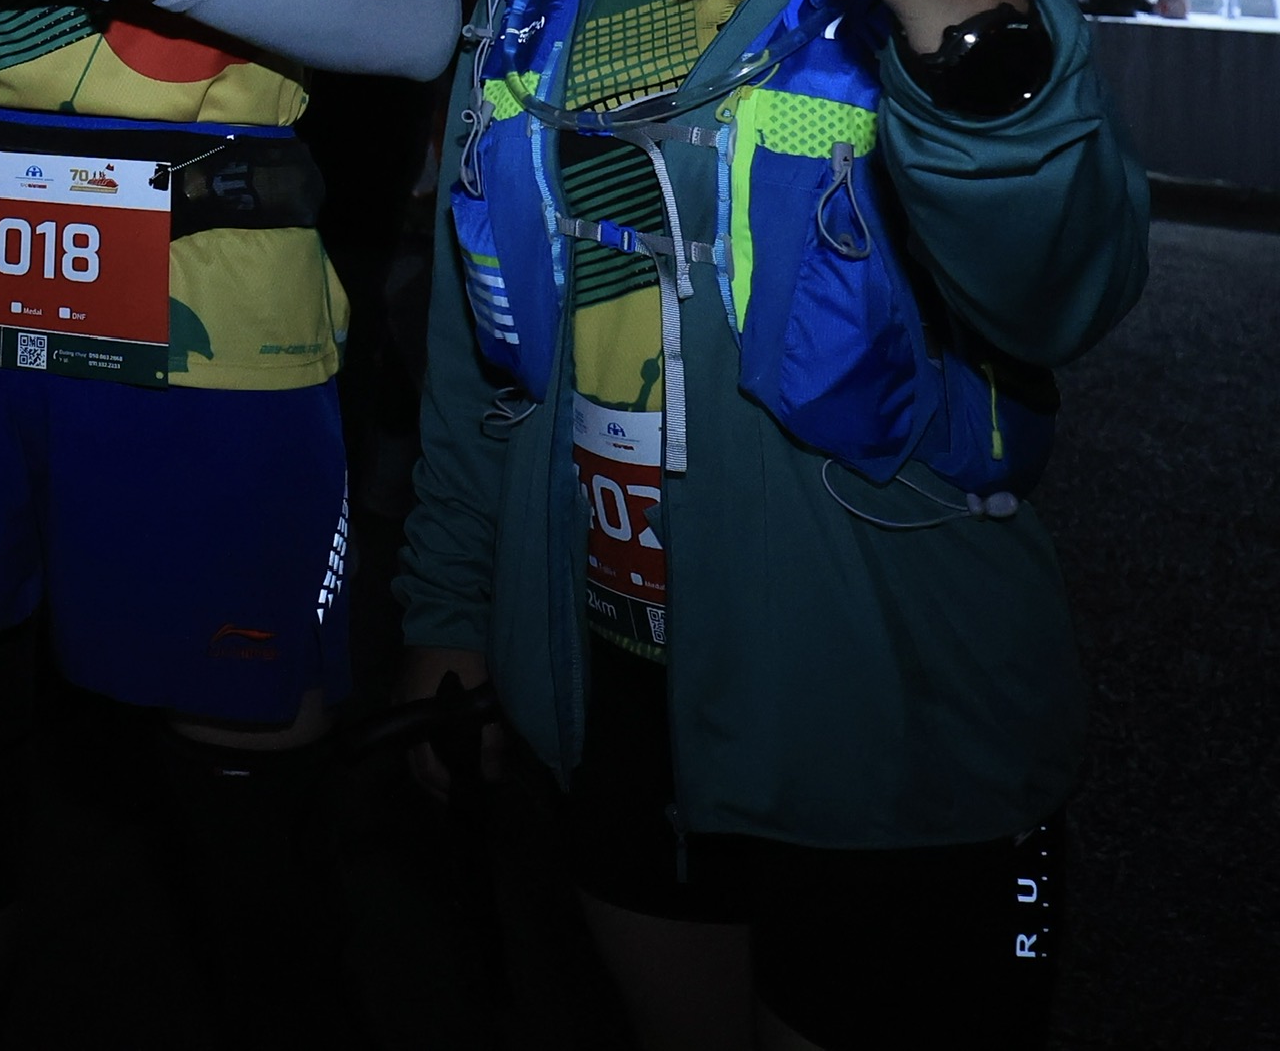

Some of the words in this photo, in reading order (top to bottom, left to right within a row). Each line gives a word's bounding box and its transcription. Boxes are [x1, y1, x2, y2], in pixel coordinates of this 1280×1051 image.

[69, 168, 90, 183] 70
[23, 306, 43, 317] Medal
[71, 311, 87, 322] DNF
